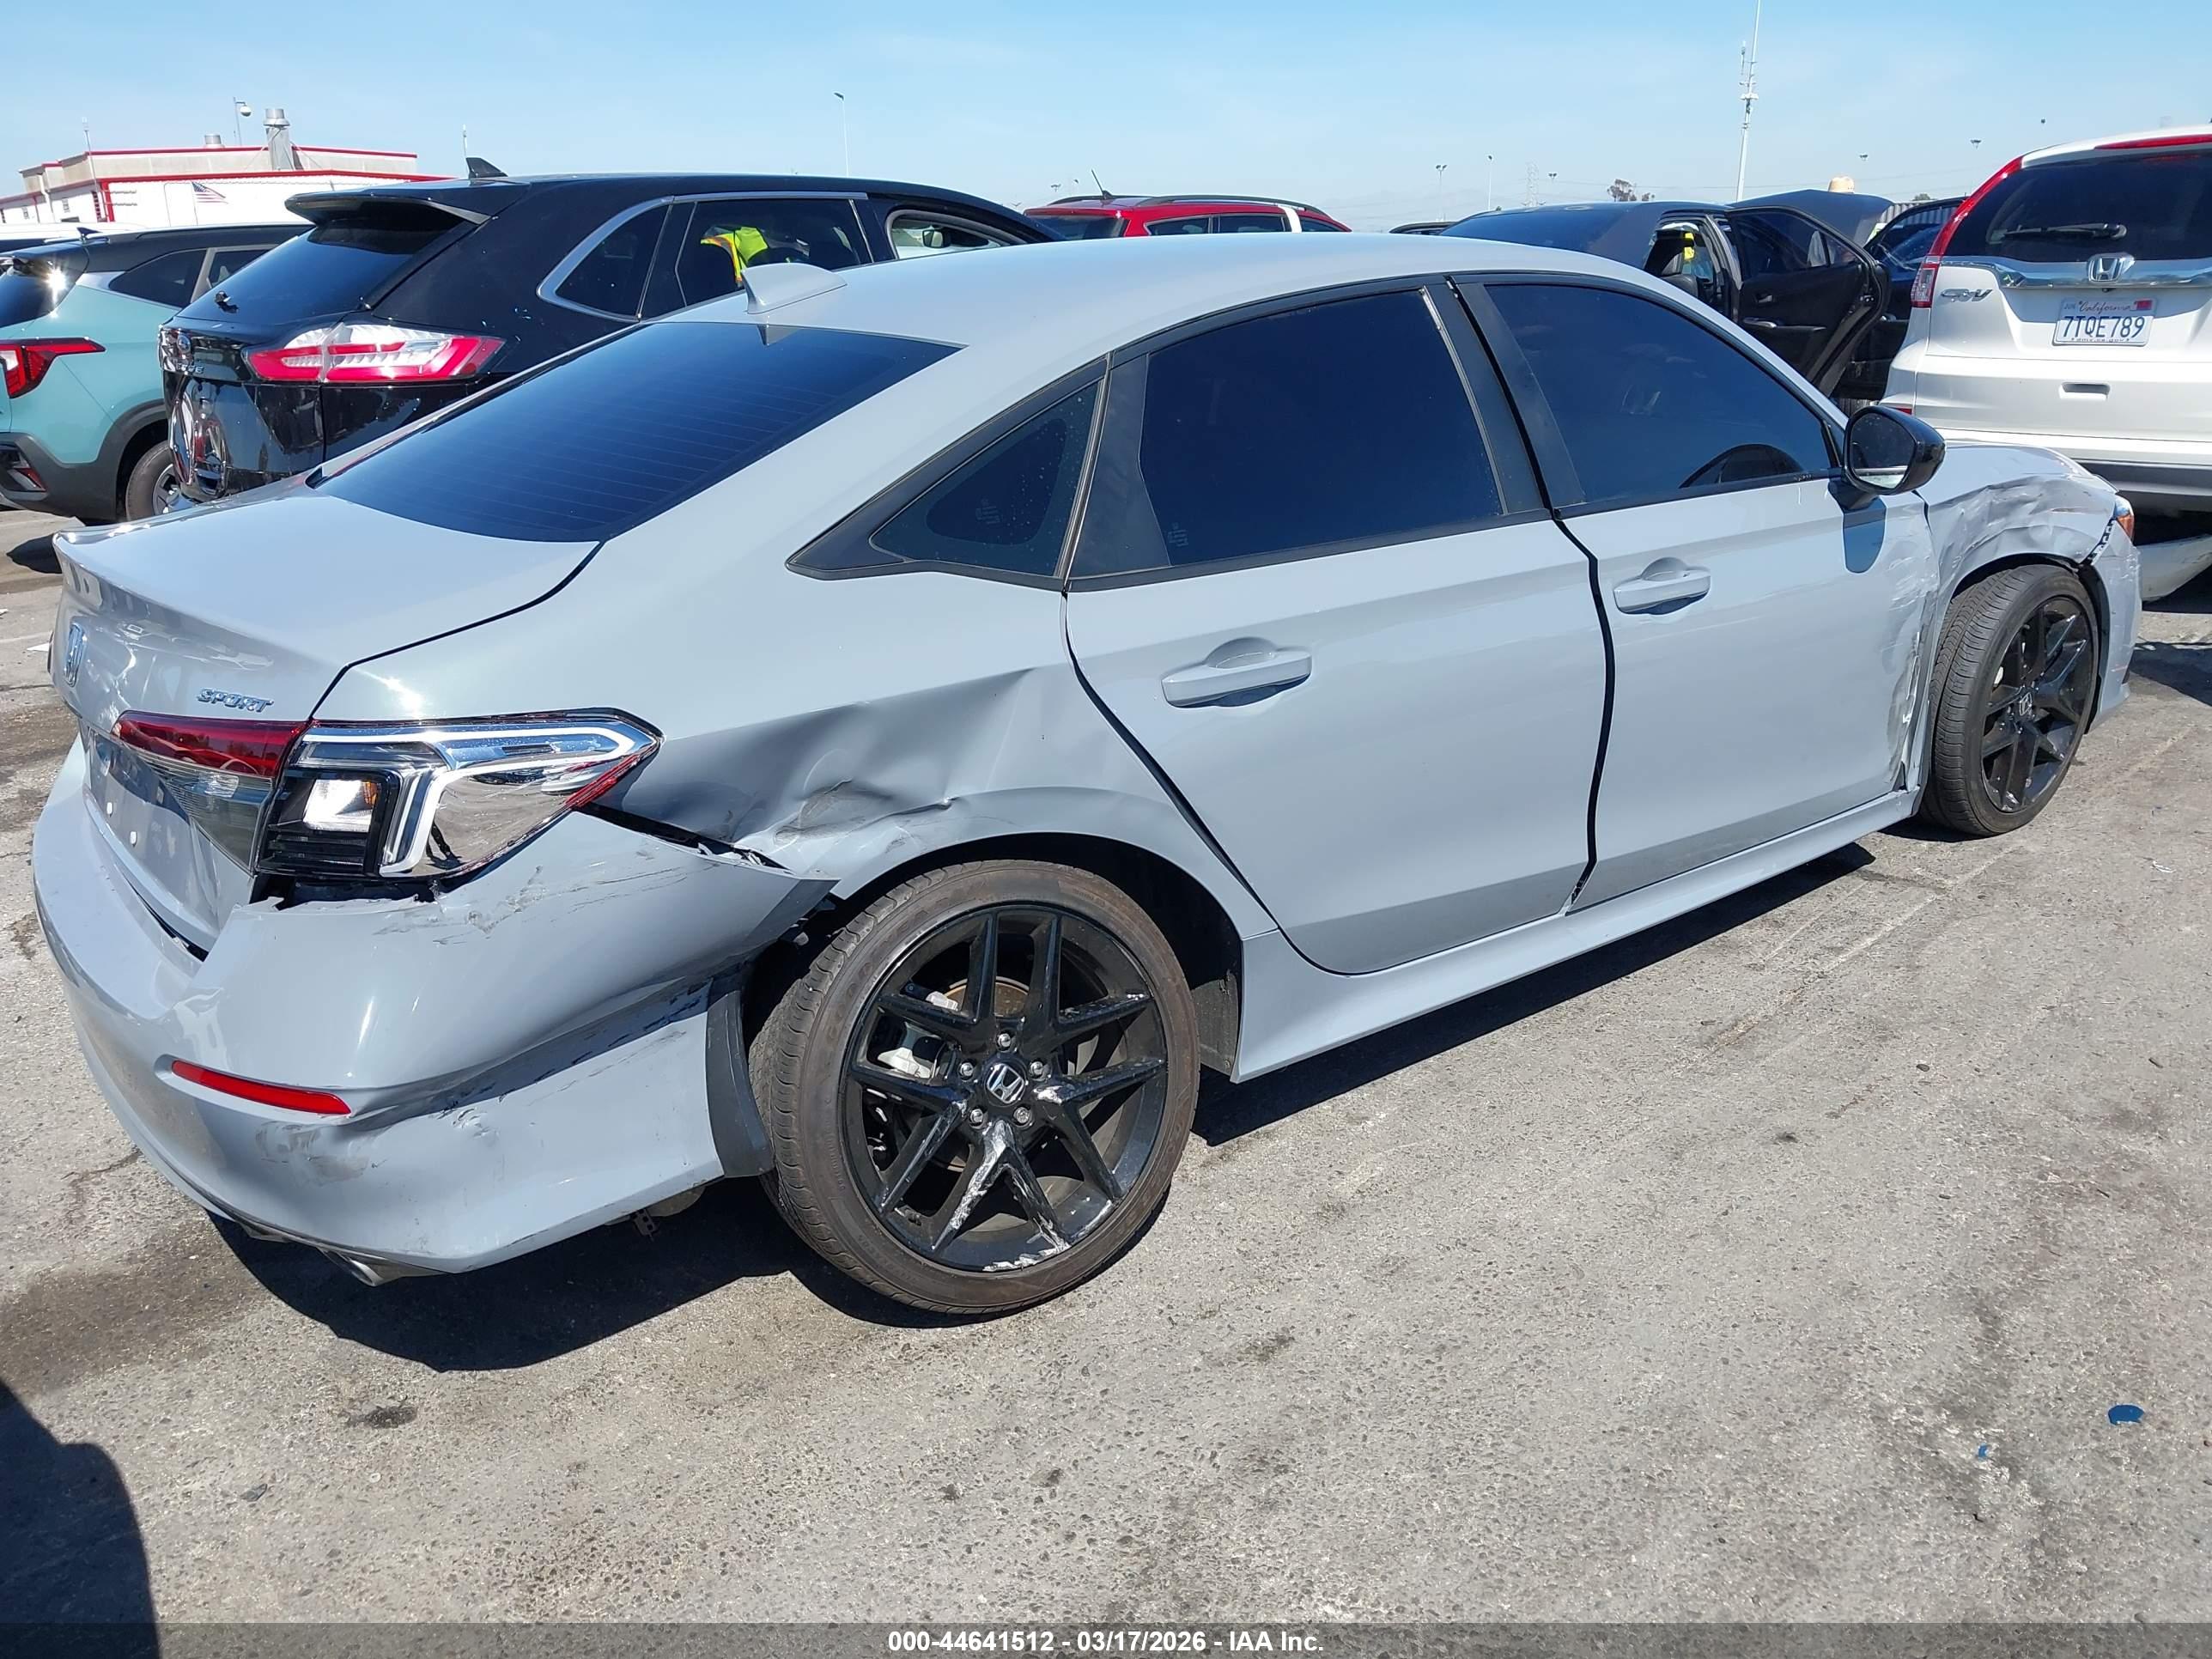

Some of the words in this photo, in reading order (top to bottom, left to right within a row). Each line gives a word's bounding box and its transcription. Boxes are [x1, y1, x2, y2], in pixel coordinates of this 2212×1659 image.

[1940, 288, 1993, 302] CR-V
[2080, 300, 2131, 314] California
[2063, 315, 2145, 338] 7TQE789
[197, 688, 275, 713] SPORT
